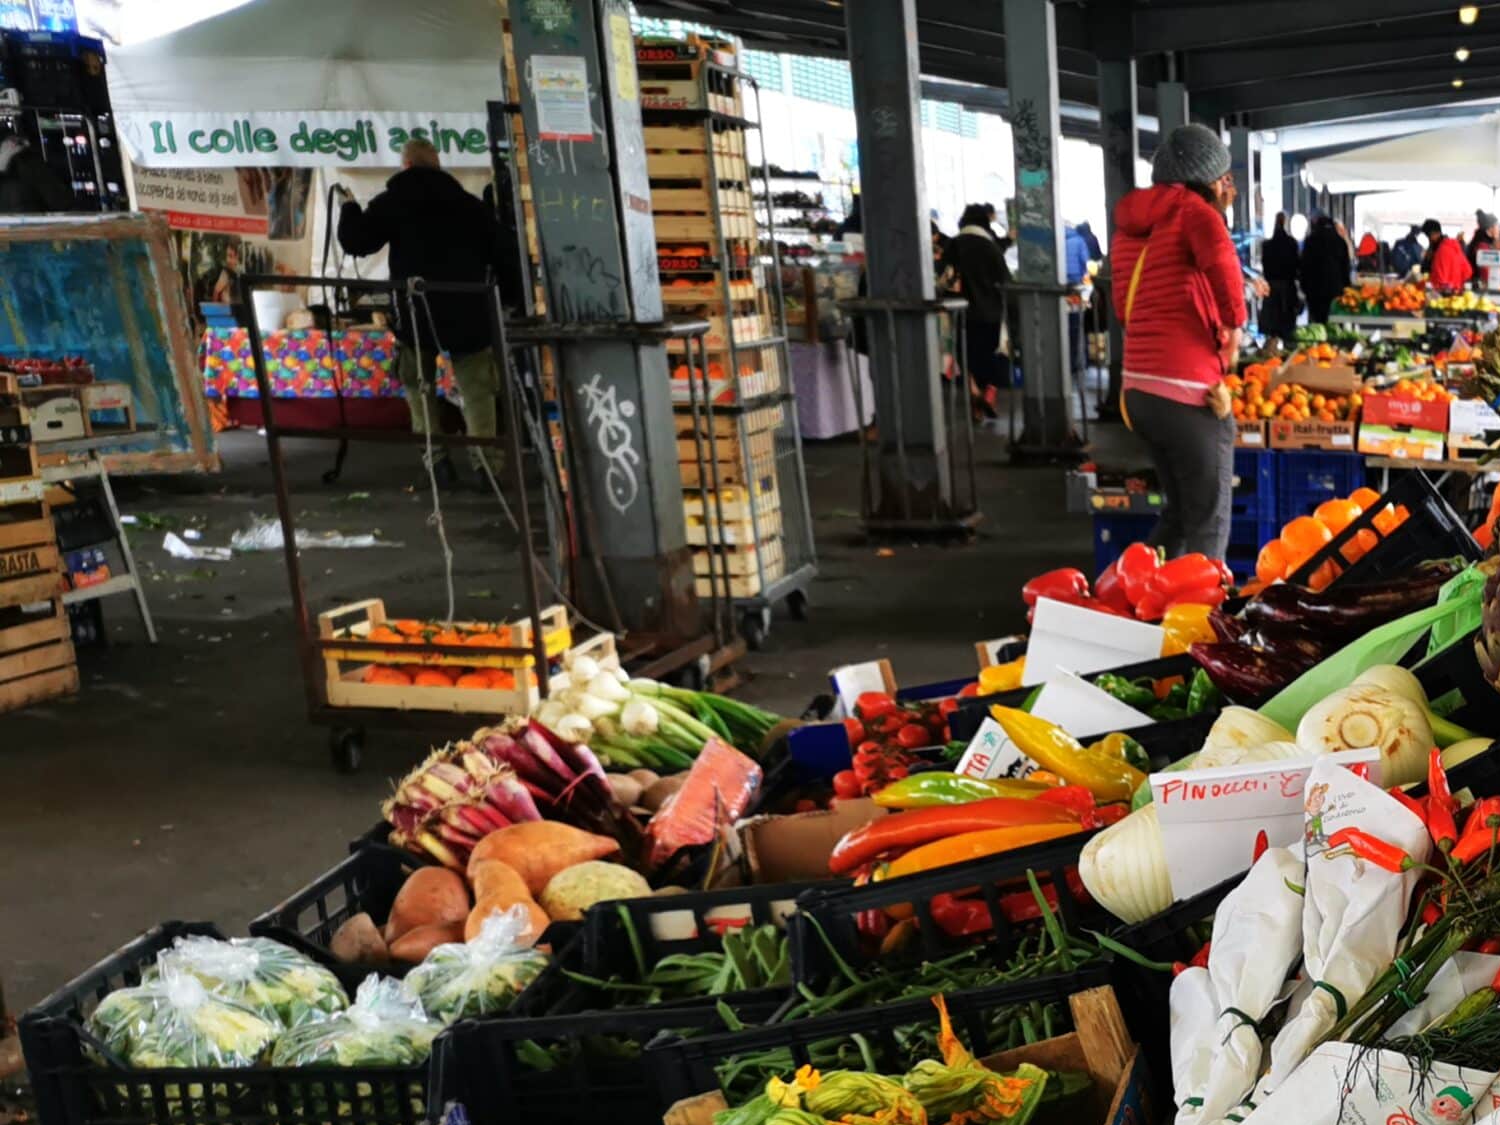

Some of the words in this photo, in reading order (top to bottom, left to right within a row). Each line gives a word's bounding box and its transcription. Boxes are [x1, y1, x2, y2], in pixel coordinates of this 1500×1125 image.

[150, 121, 177, 153] Il
[188, 120, 276, 153] colle
[290, 120, 378, 161] degli
